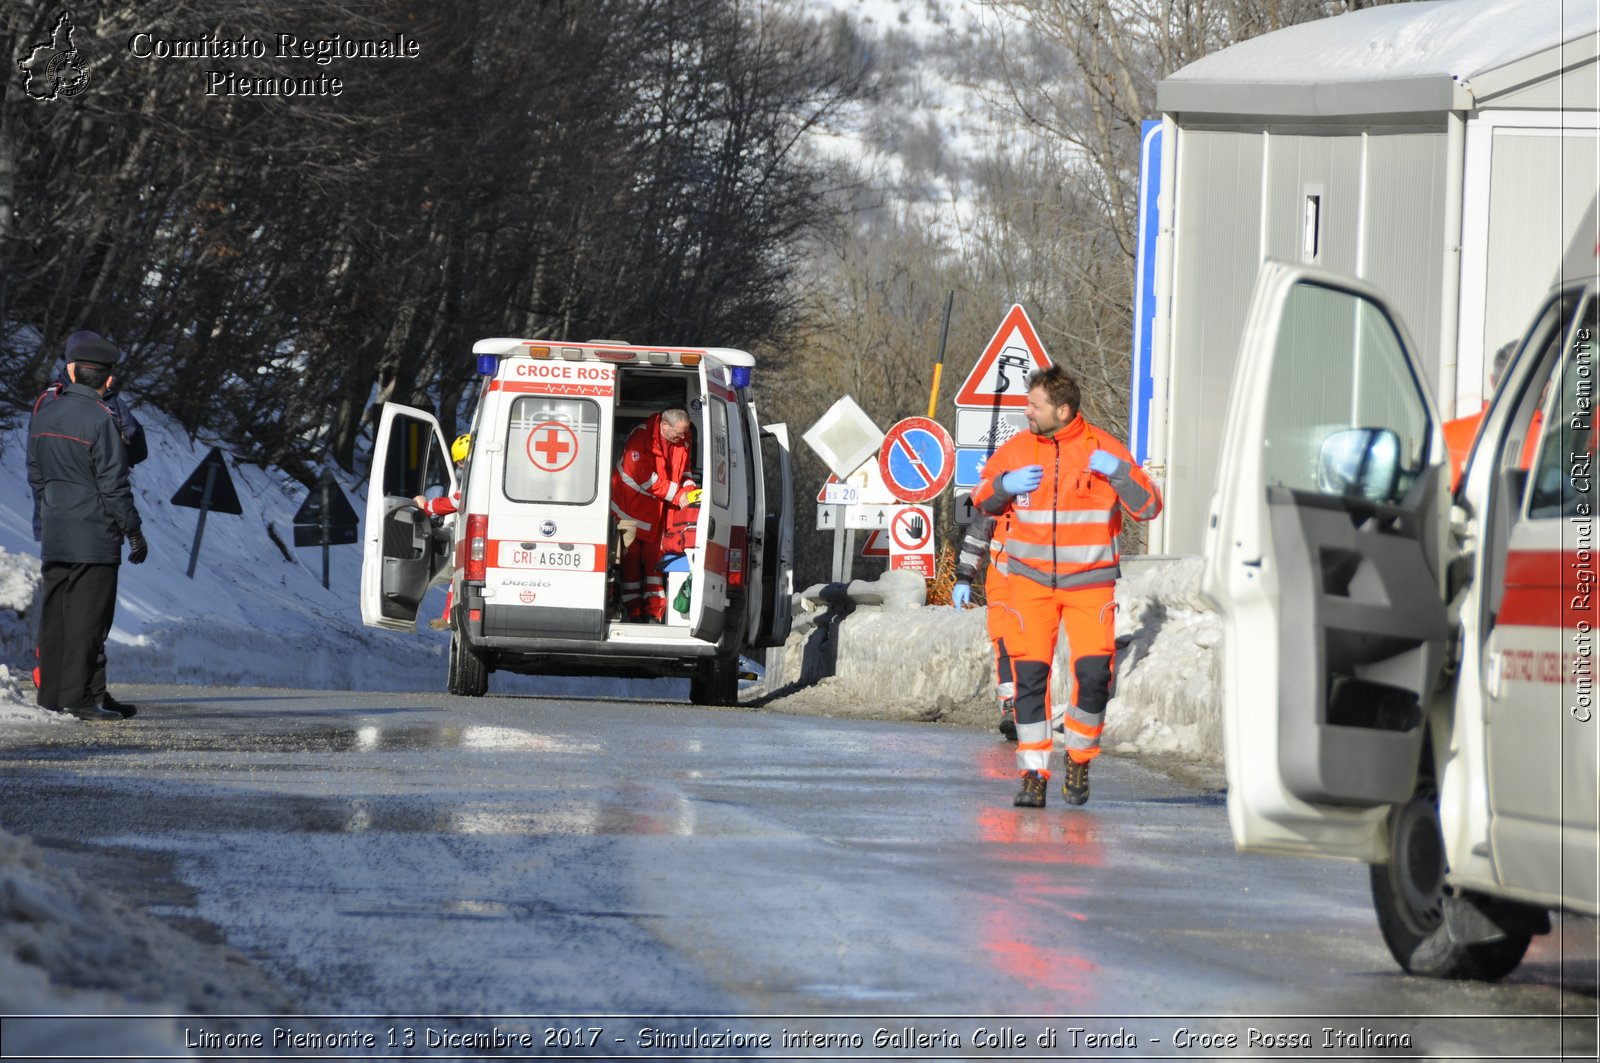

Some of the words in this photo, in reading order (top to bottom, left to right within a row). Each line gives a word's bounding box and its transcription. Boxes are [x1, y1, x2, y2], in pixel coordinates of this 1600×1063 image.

[516, 364, 571, 379] CROCE
[842, 488, 856, 501] 20
[513, 550, 532, 564] CRI
[501, 579, 551, 588] Ducato
